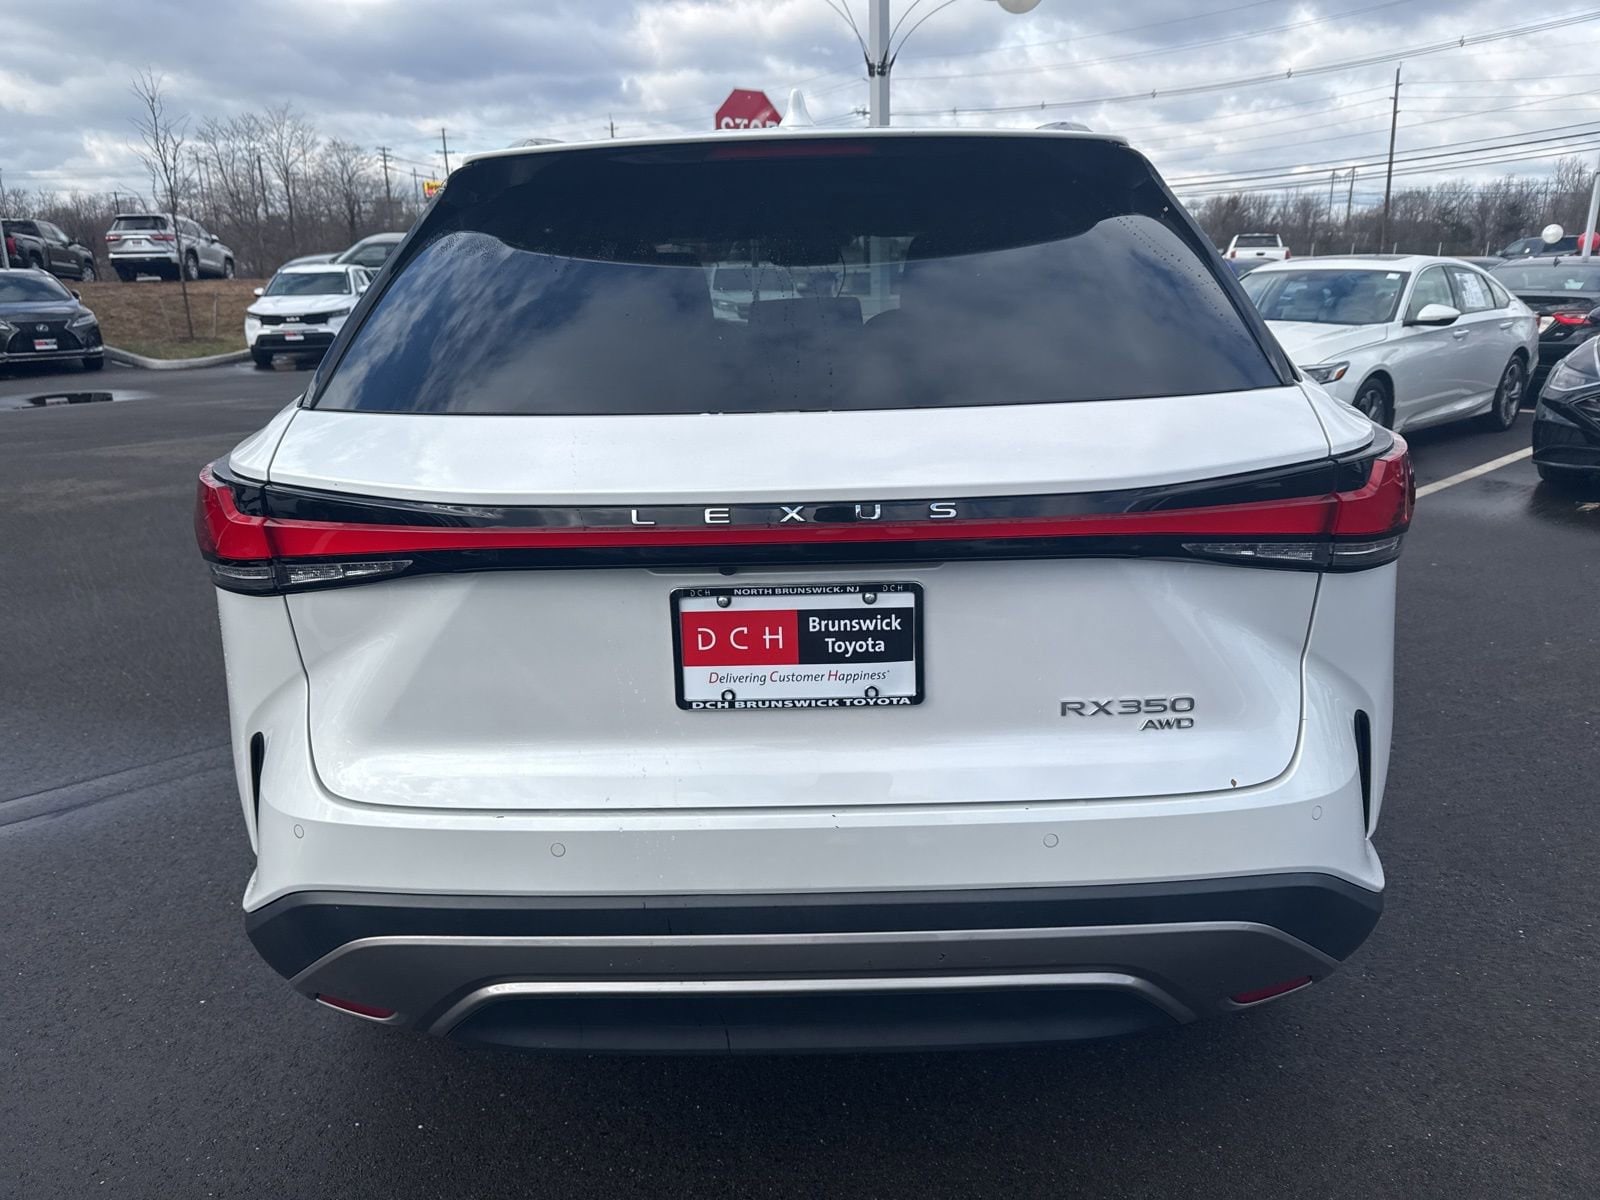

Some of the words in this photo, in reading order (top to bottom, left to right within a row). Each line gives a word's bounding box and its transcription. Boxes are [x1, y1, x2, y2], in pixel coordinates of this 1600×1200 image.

[631, 502, 957, 525] LEXUS
[690, 589, 711, 597] DCH
[882, 584, 903, 592] DCH
[809, 614, 902, 632] Brunswick
[697, 626, 783, 651] DCH
[825, 637, 885, 657] Toyota
[709, 672, 767, 685] Delivering
[769, 671, 825, 682] Customer
[827, 670, 887, 684] Happiness
[692, 701, 729, 709] DCH
[734, 699, 839, 708] BRUNSWICK
[843, 697, 911, 706] TOYOTA
[1060, 697, 1195, 717] RX350
[1139, 717, 1194, 731] AWD
